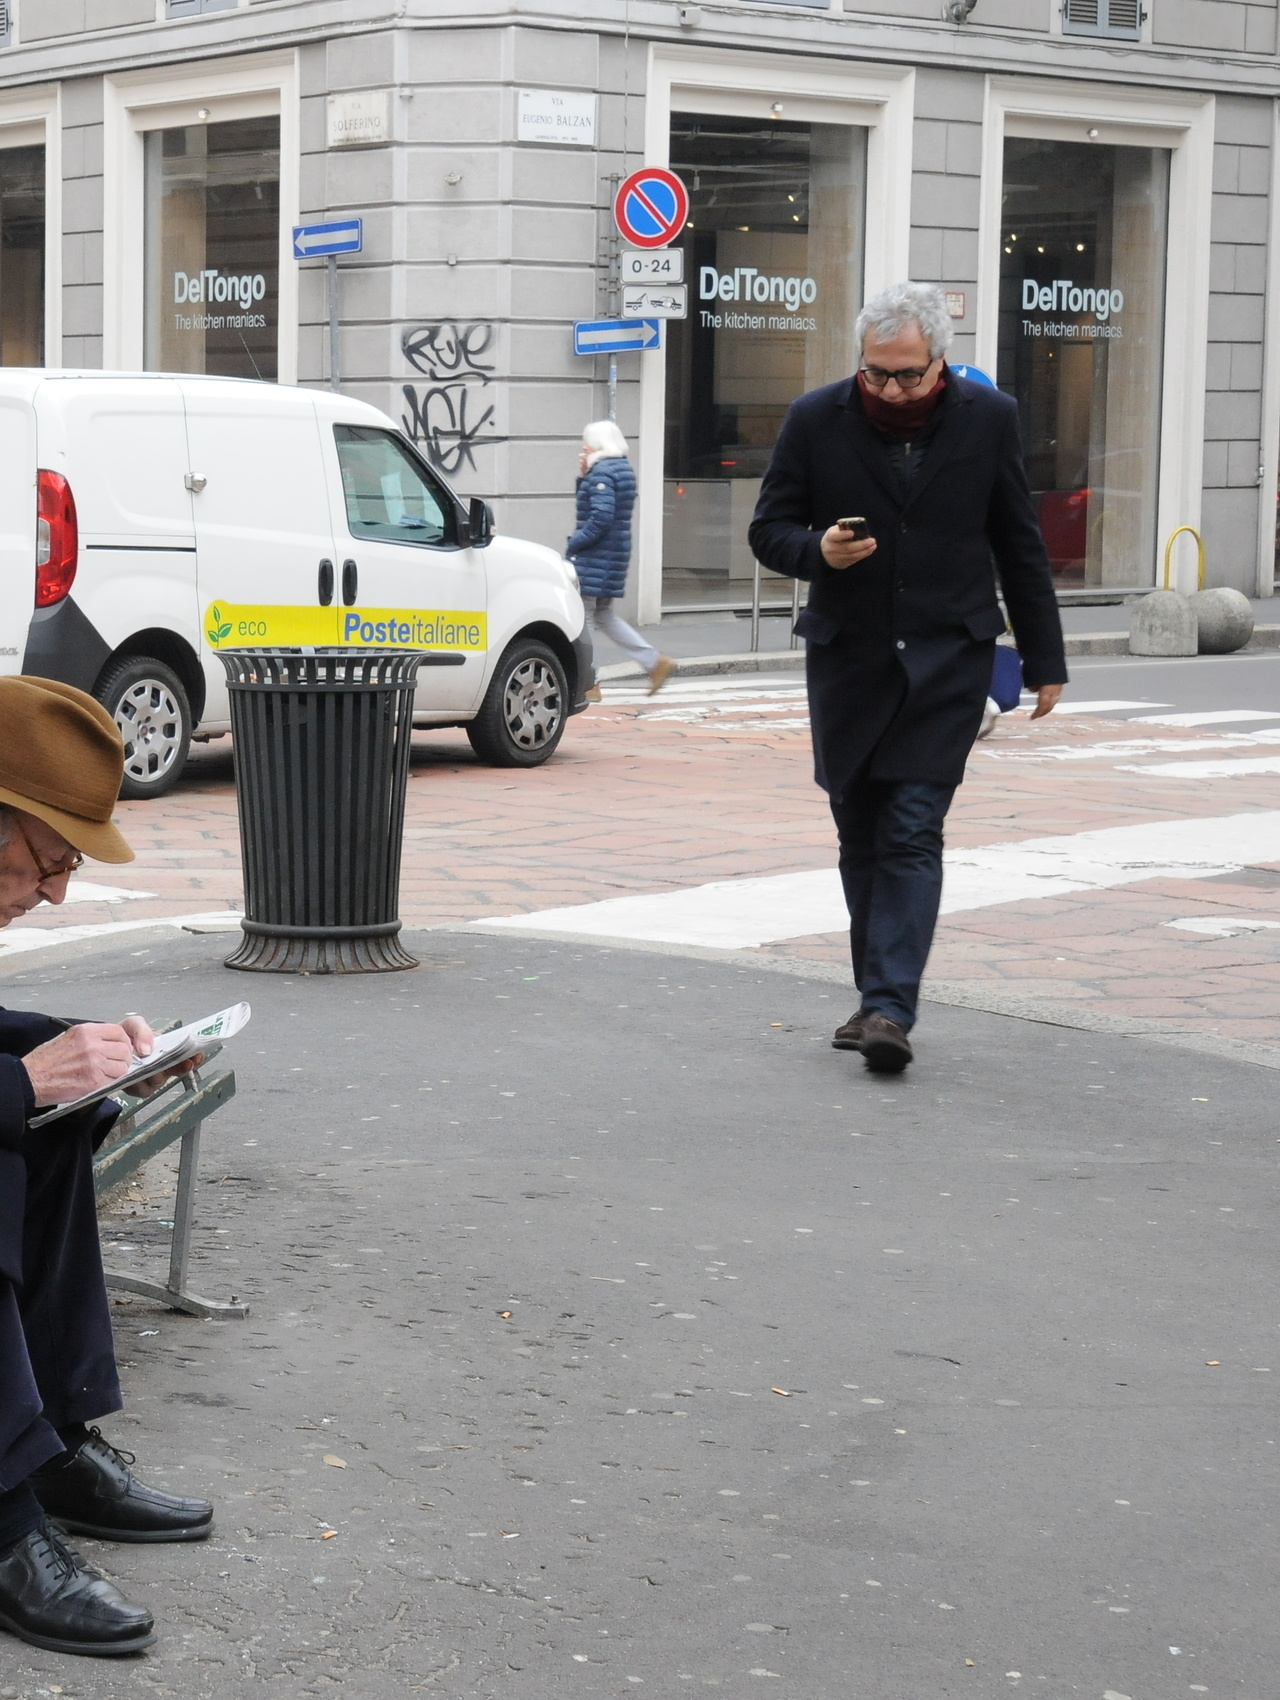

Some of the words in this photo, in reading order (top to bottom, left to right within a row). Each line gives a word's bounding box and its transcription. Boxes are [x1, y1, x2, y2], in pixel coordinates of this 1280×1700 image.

[552, 98, 563, 106] VIA
[333, 117, 381, 132] SOLFERINO
[523, 114, 553, 124] EUGENIO
[557, 115, 592, 127] BALZAN
[174, 269, 266, 309] DelTongo
[699, 266, 817, 311] DelTongo
[1022, 279, 1124, 320] DelTongo
[175, 314, 191, 330] The
[193, 313, 224, 330] kitchen
[226, 312, 267, 328] maniacs.
[700, 310, 721, 328] The
[724, 312, 766, 329] kitchen
[769, 314, 817, 330] maniacs.
[1022, 320, 1041, 336] The
[1043, 321, 1078, 337] kitchen
[1082, 322, 1124, 338] maniacs.
[238, 621, 267, 636] eco
